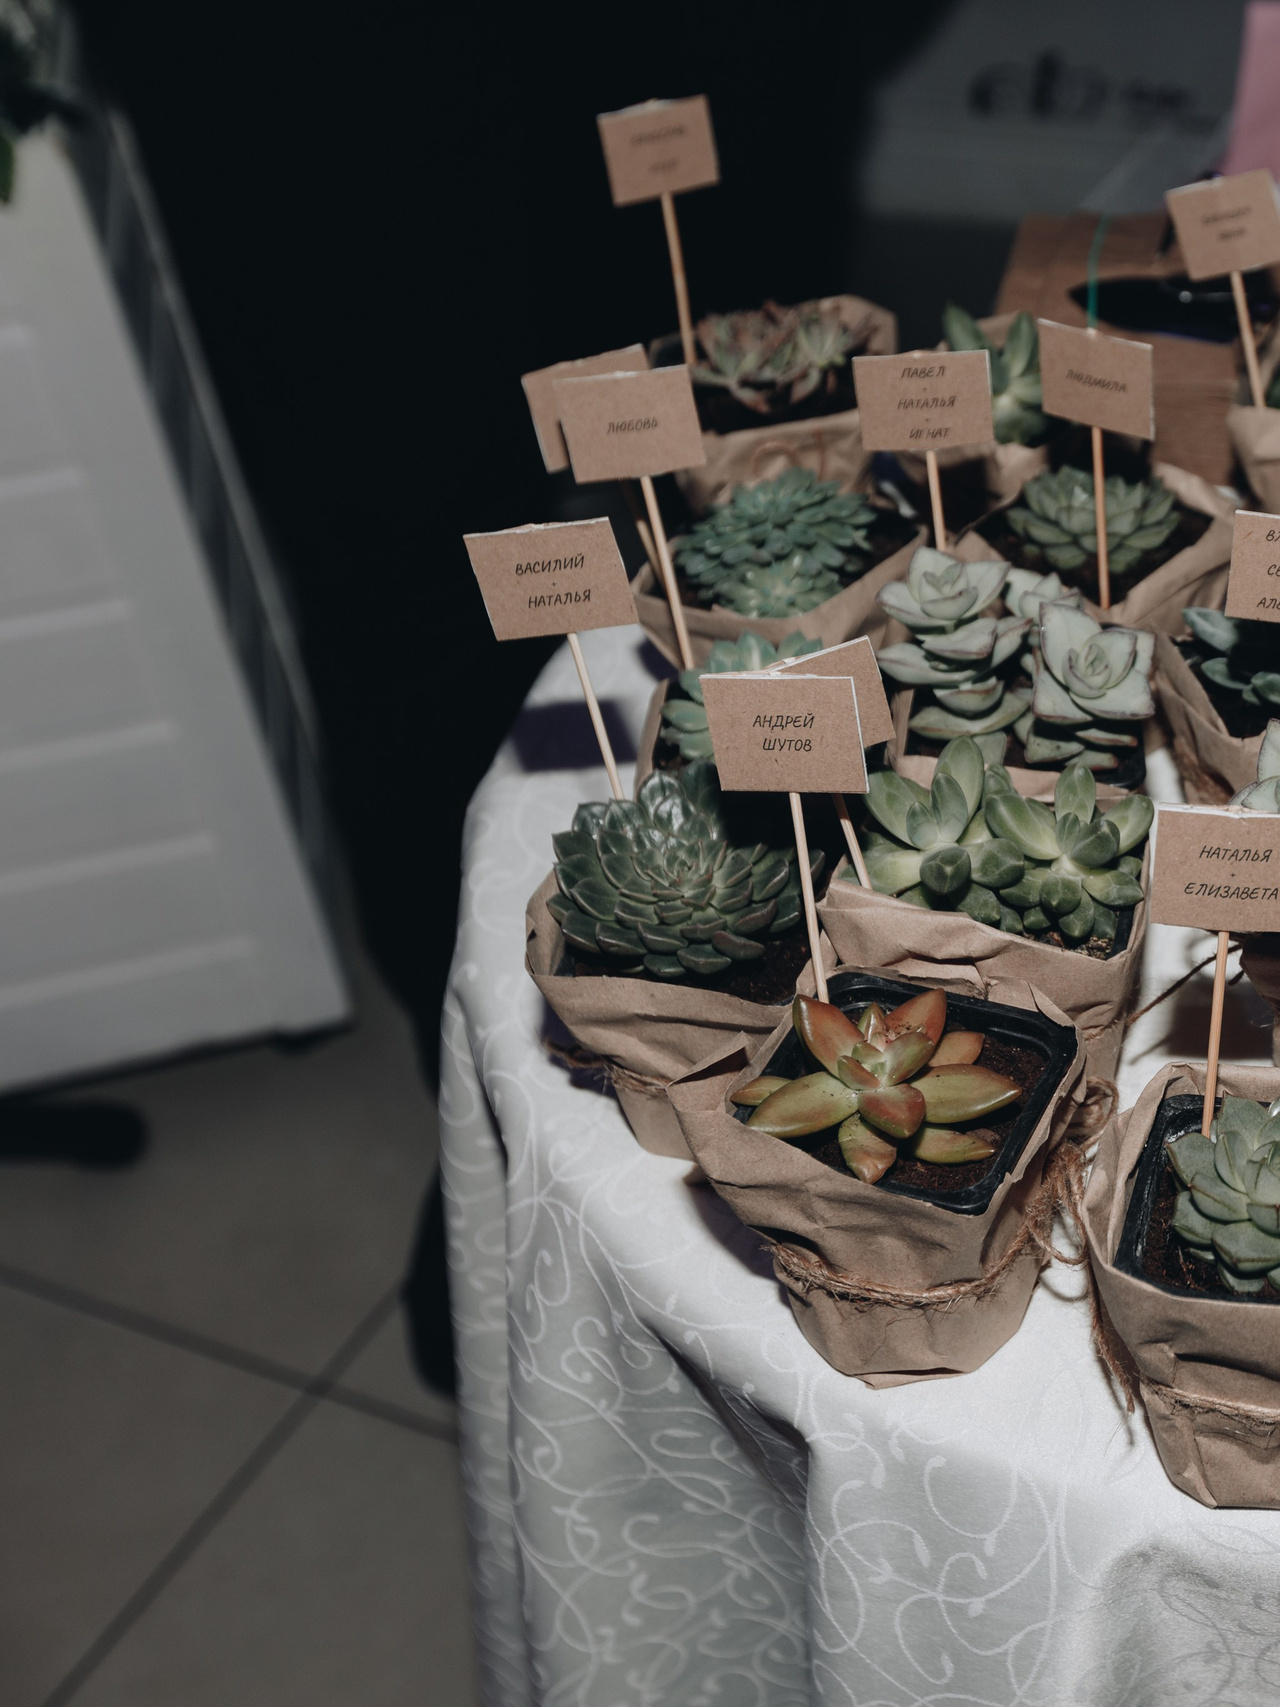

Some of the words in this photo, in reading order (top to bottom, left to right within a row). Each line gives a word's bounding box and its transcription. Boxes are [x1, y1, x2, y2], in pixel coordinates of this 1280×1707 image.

[901, 366, 946, 379] ПАВЕЛ
[1065, 369, 1128, 392] ЛЮДМИЛА
[897, 396, 956, 409] НАТАЛЬЯ
[606, 417, 658, 434] ЛЮБОВЬ
[909, 427, 950, 439] ИГНАТ
[515, 553, 585, 575] ВАСИЛИЙ
[528, 589, 591, 608] НАТАЛЬЯ
[752, 713, 815, 730] АНДРЕЙ
[762, 738, 813, 752] ШУТОВ
[1199, 845, 1273, 863] НАТАЛЬЯ
[1184, 882, 1279, 901] ЕЛИЗАВЕТА
